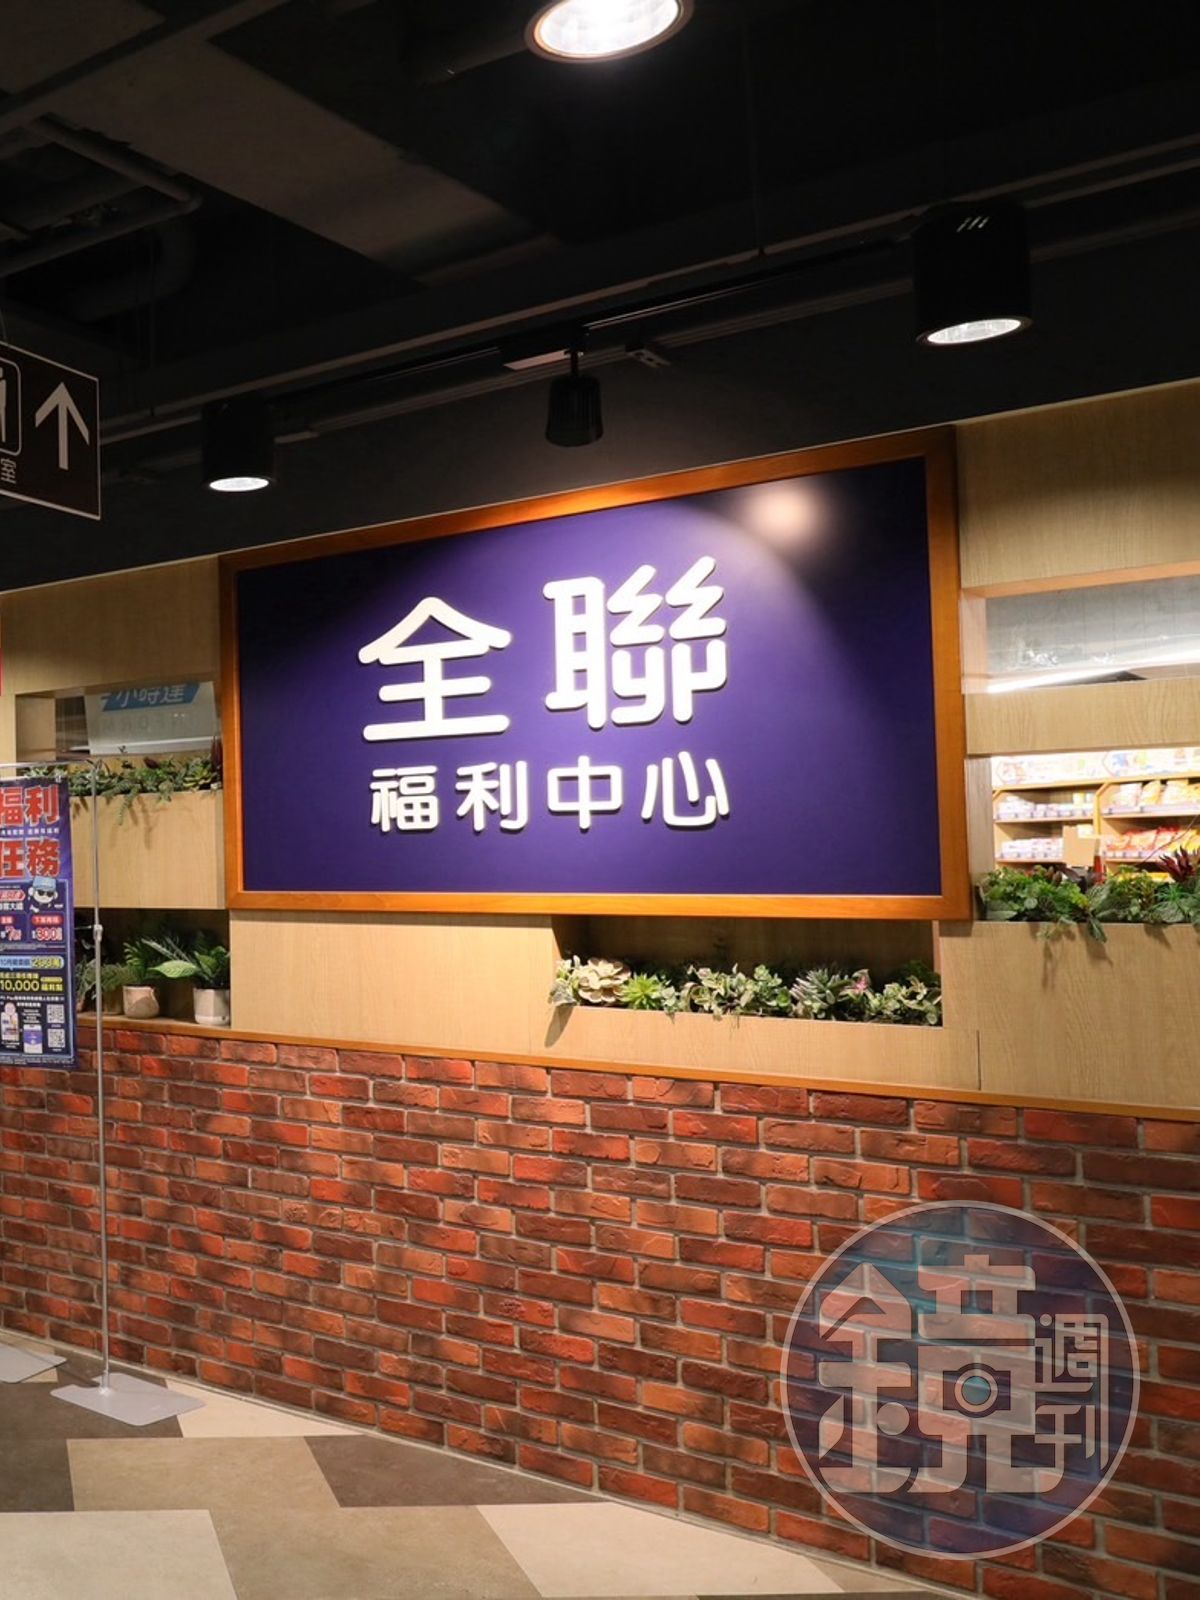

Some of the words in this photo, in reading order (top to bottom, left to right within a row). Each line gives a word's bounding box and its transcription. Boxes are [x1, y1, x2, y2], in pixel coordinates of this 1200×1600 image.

[357, 555, 728, 743] 全聯
[370, 750, 730, 833] 福利中心
[0, 980, 40, 992] 10,000
